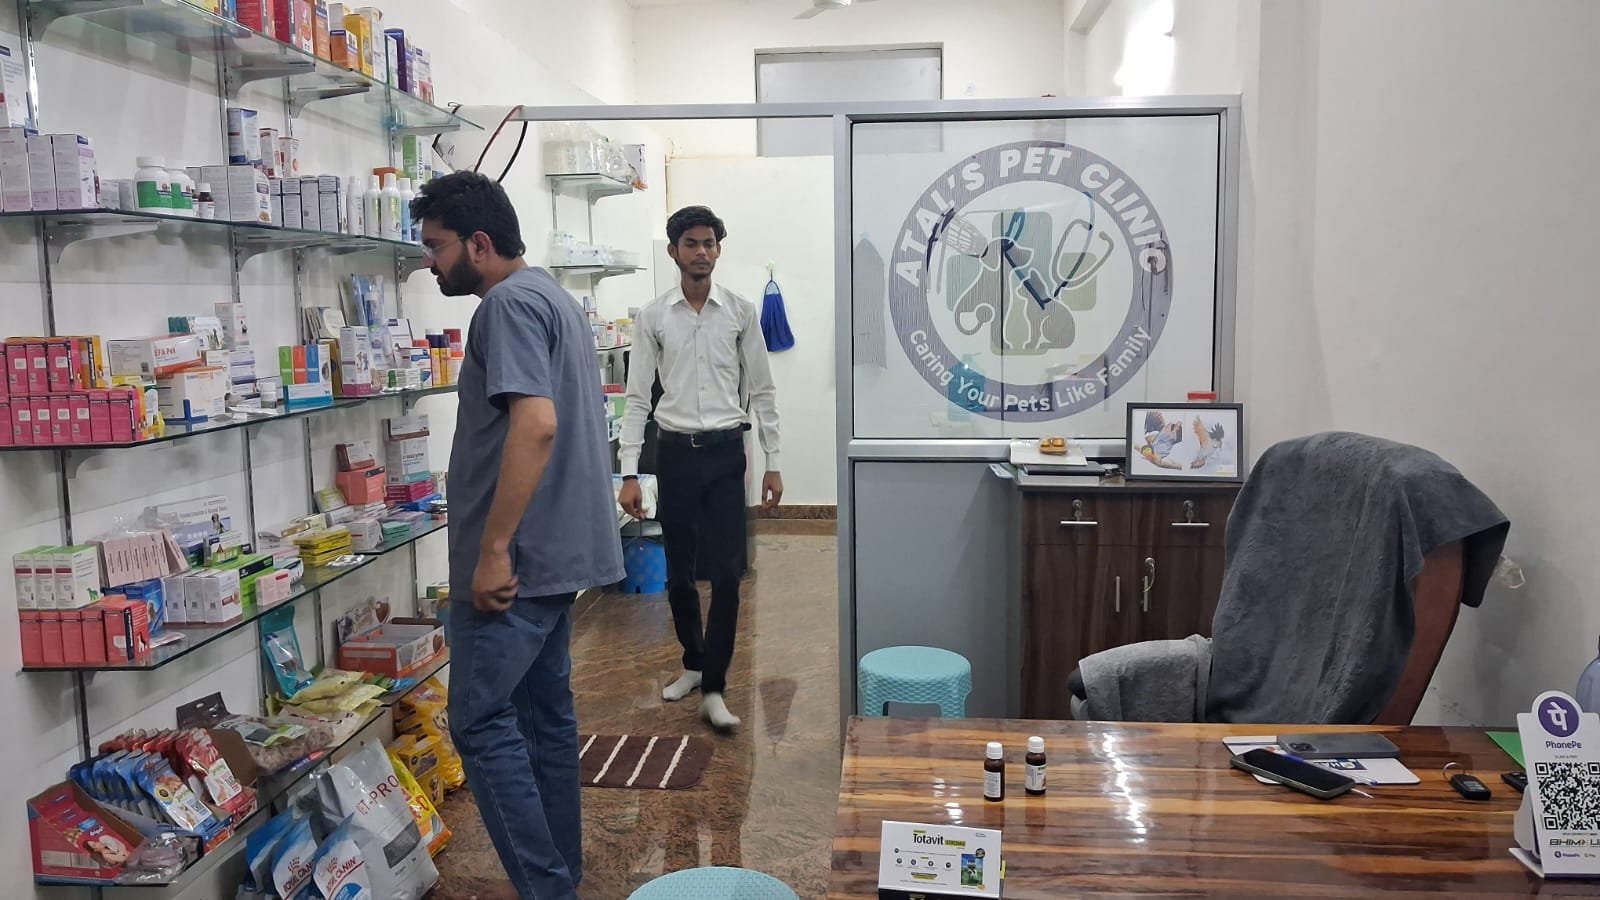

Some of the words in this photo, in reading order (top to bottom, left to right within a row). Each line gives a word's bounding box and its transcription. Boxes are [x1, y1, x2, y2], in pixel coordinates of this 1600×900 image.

[895, 162, 985, 287] ATAL'S
[999, 146, 1072, 178] PET
[1080, 163, 1167, 273] CLINIC
[910, 329, 954, 387] Caring
[957, 376, 1002, 409] Your
[1003, 394, 1051, 412] Pets
[1055, 379, 1097, 408] Like
[1096, 326, 1152, 387] Family
[1545, 740, 1582, 749] PhonePe
[913, 833, 944, 846] Totavit
[1549, 838, 1583, 846] BHIM
